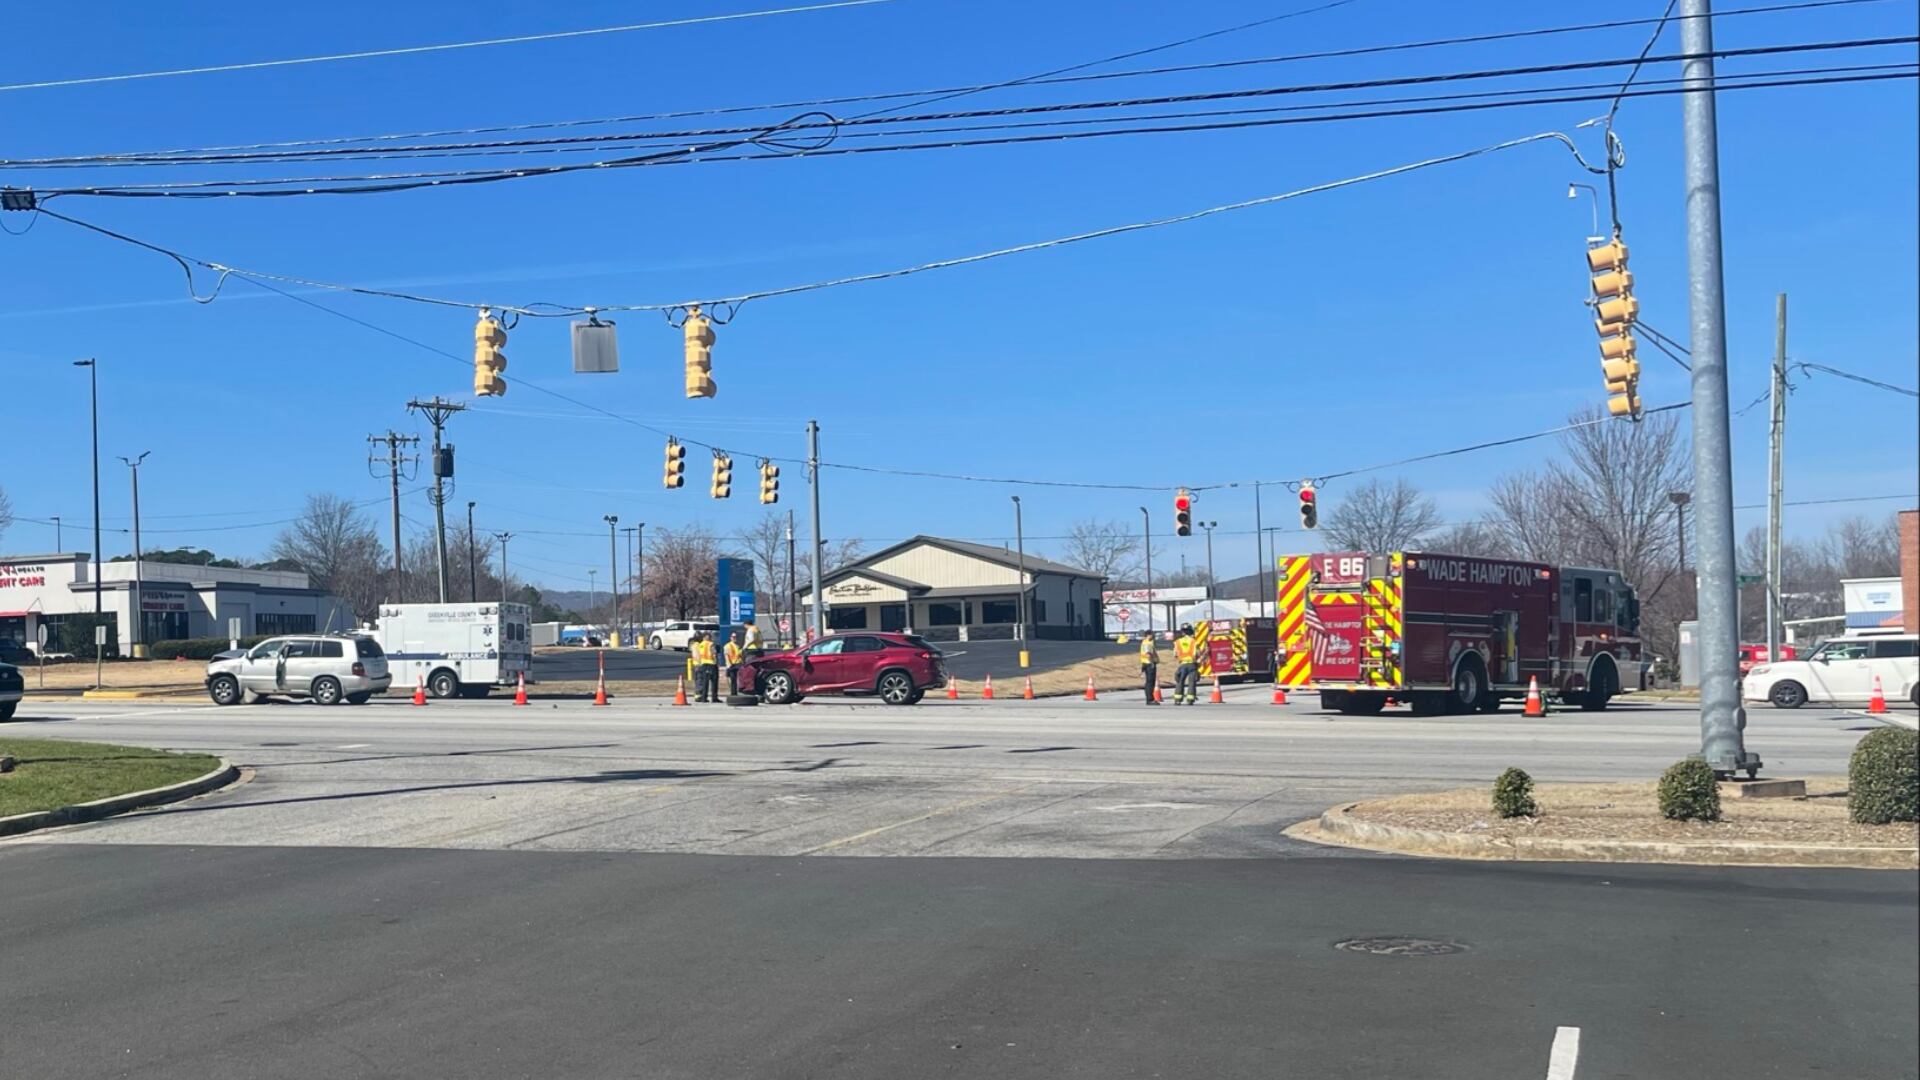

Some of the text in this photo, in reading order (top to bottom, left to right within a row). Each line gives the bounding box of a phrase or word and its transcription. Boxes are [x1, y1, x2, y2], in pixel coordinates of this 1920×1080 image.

[1324, 557, 1364, 577] E 86
[1426, 559, 1532, 587] WADE HAMPTON
[19, 576, 45, 587] CARE
